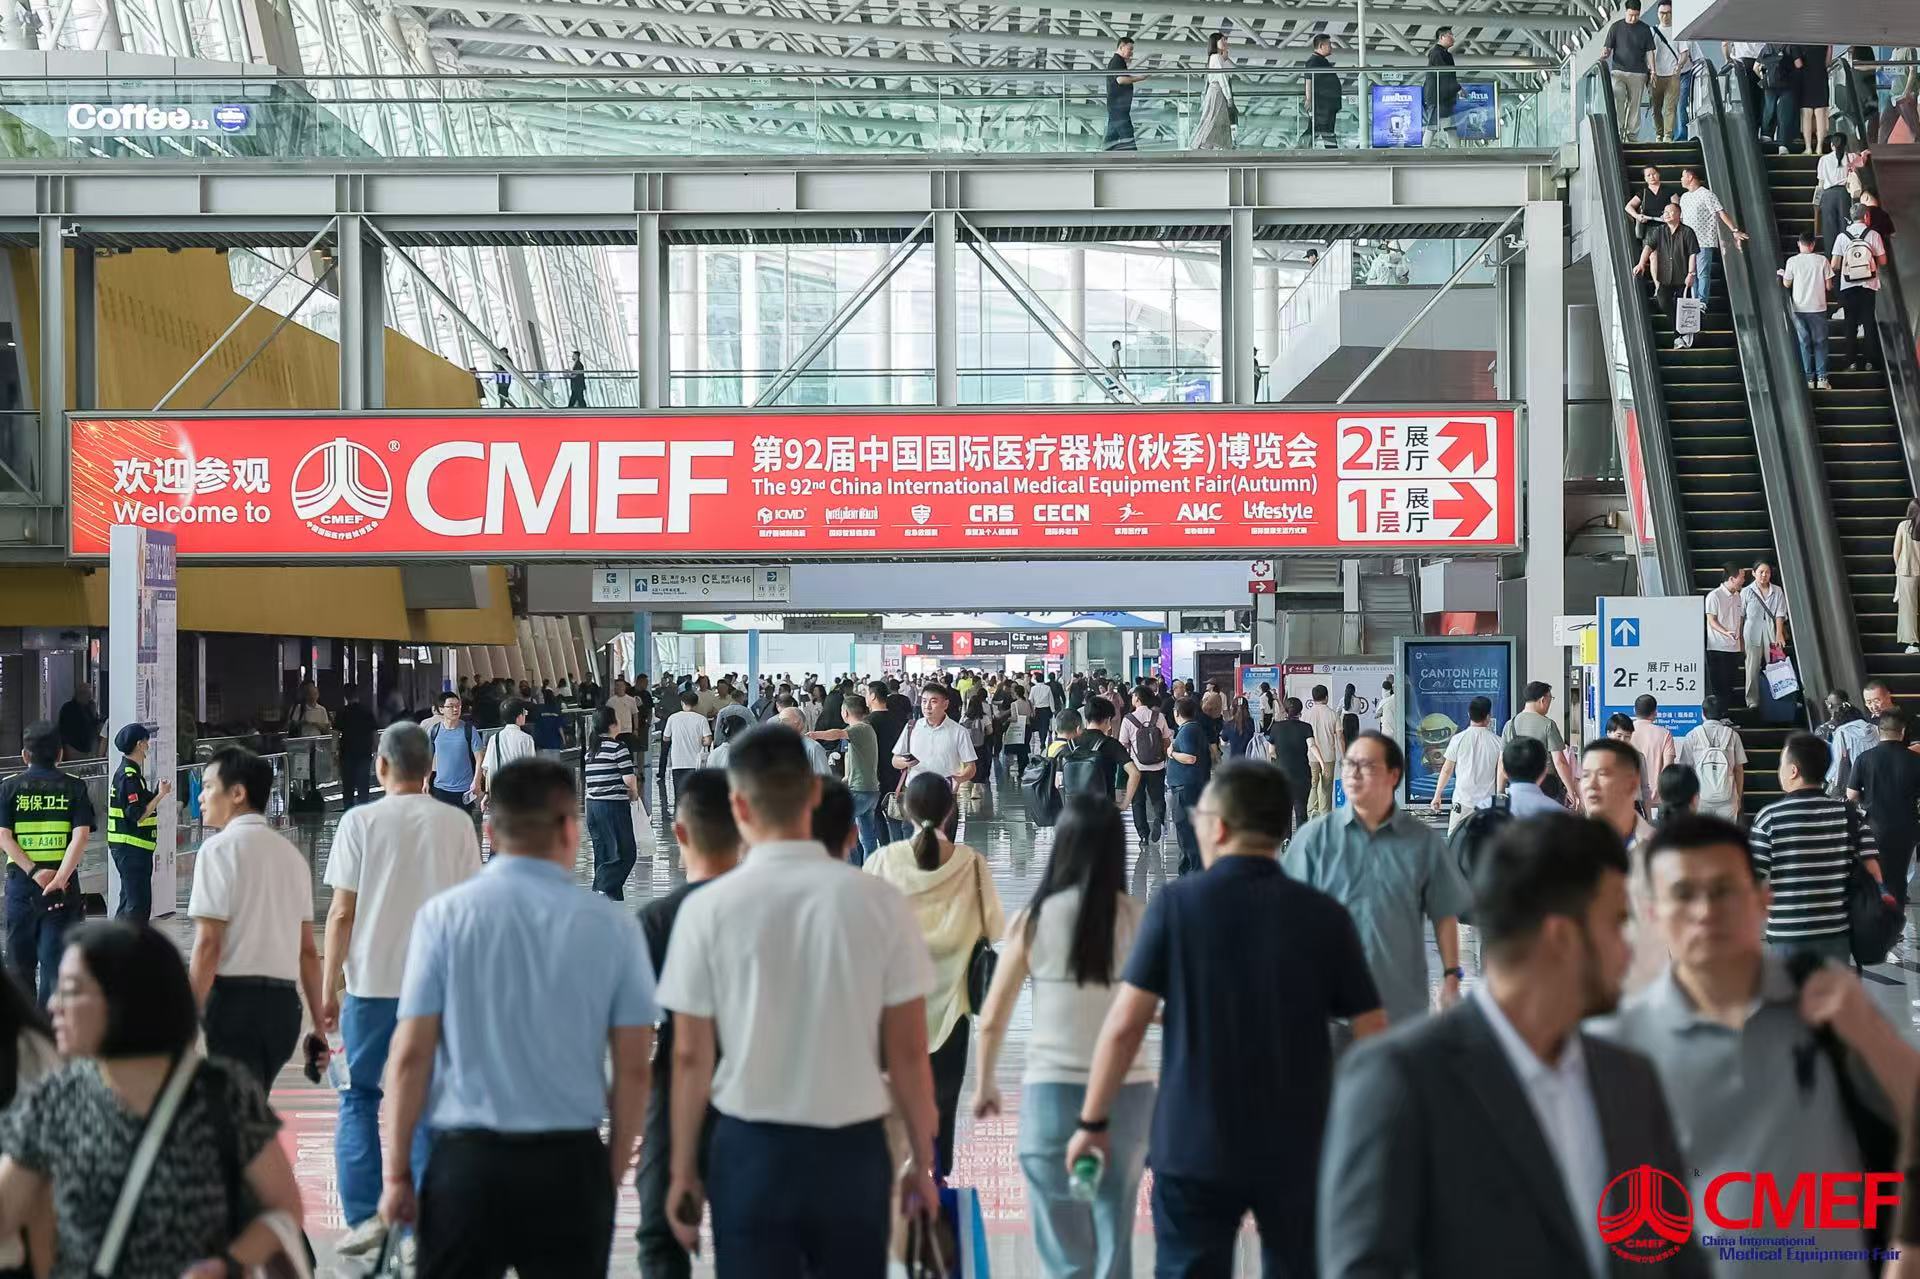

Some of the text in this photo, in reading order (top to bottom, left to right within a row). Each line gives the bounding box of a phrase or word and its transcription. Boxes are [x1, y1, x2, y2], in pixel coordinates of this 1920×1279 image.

[67, 103, 190, 130] Coffee
[751, 432, 1318, 474] 第92届中国国际医疗器械(秋季)博览会
[113, 457, 271, 494] 欢迎参观
[405, 440, 735, 536] CMEF
[751, 474, 1318, 497] The 92nd China International Medical Equipment Fair(Autumn)
[112, 501, 271, 524] Welcome to
[320, 515, 364, 525] CMEF
[969, 504, 1015, 523] CRS
[1033, 503, 1090, 522] CECN
[1243, 501, 1313, 524] Lifestyle
[651, 574, 659, 585] B
[680, 575, 697, 583] 9-13
[701, 574, 710, 584] C
[731, 574, 751, 583] 14-16
[974, 638, 980, 646] B
[1421, 668, 1498, 678] CANTON FAIR
[1647, 662, 1697, 673] 展厅 Hall
[1453, 679, 1499, 689] CENTER
[1613, 668, 1639, 687] 2F
[16, 795, 69, 811] 海保卫士
